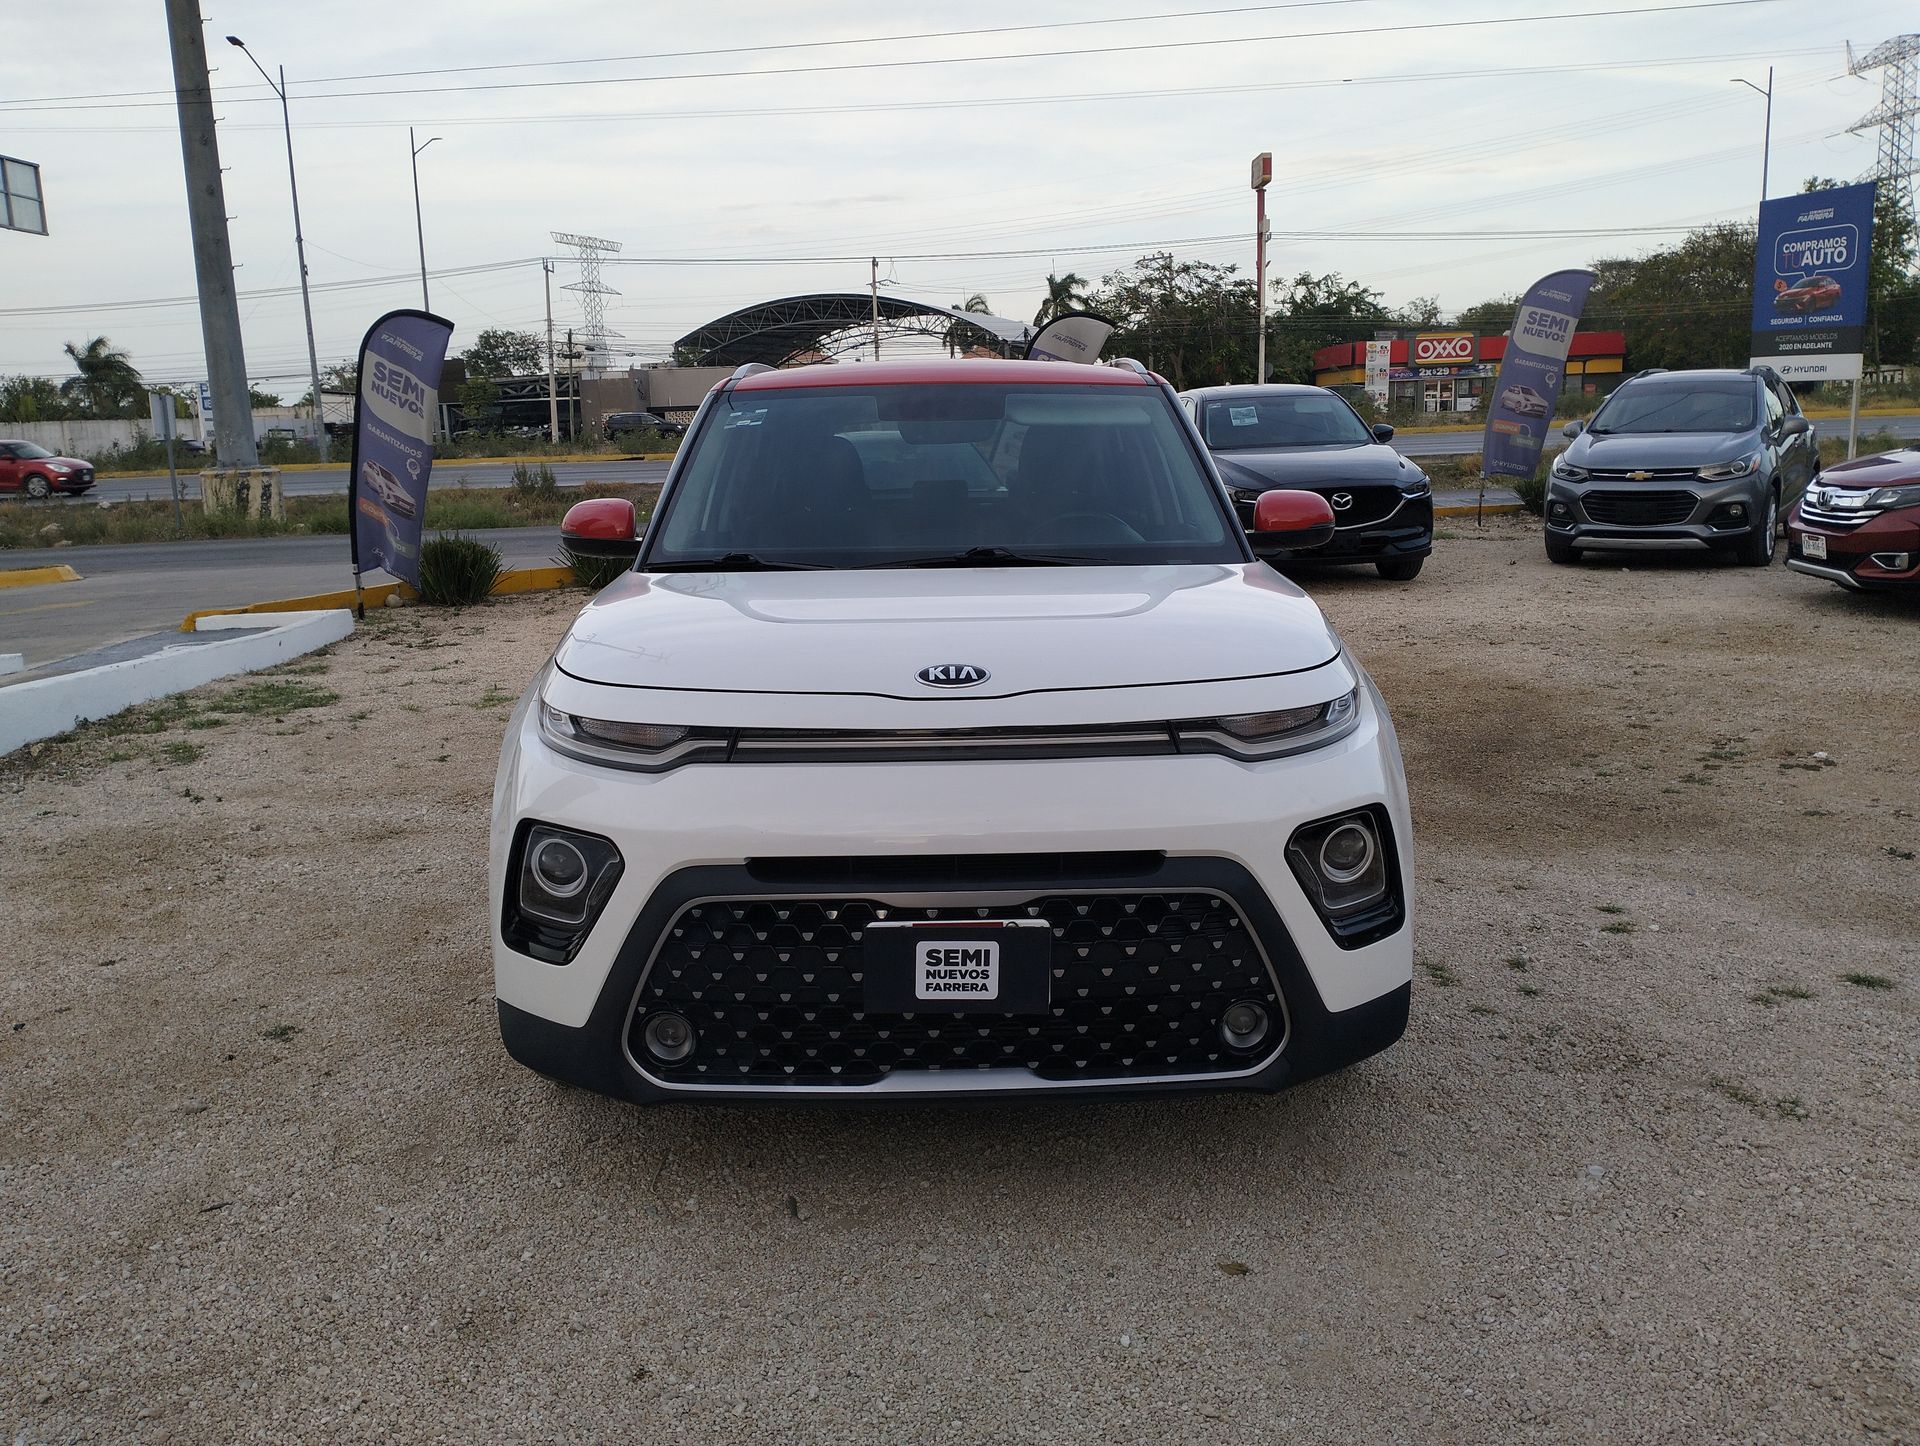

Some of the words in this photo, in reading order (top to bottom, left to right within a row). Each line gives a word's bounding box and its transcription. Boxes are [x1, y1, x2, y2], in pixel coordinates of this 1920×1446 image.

[1797, 212, 1834, 223] FARRERA
[1783, 236, 1847, 253] COMPRAMOS
[1526, 310, 1570, 334] SEMI
[1770, 317, 1802, 325] SEGURIDAD
[1809, 314, 1843, 323] CONFIANZA
[1523, 326, 1565, 343] NUEVOS
[1775, 333, 1808, 342] ACEPTAMOS
[1810, 332, 1838, 340] MODELOS
[1418, 337, 1472, 360] OXXO
[1803, 341, 1832, 349] ADELANTE
[1514, 358, 1559, 372] GARANTIZADOS
[1794, 365, 1827, 373] HYUNDAI
[373, 361, 425, 406] SEMI
[371, 380, 424, 419] NUEVOS
[367, 423, 423, 458] GARANTIZADOS
[928, 666, 979, 681] KIA
[925, 949, 991, 967] SEMI
[925, 969, 990, 980] NUEVOS
[925, 982, 989, 992] FARRERA
